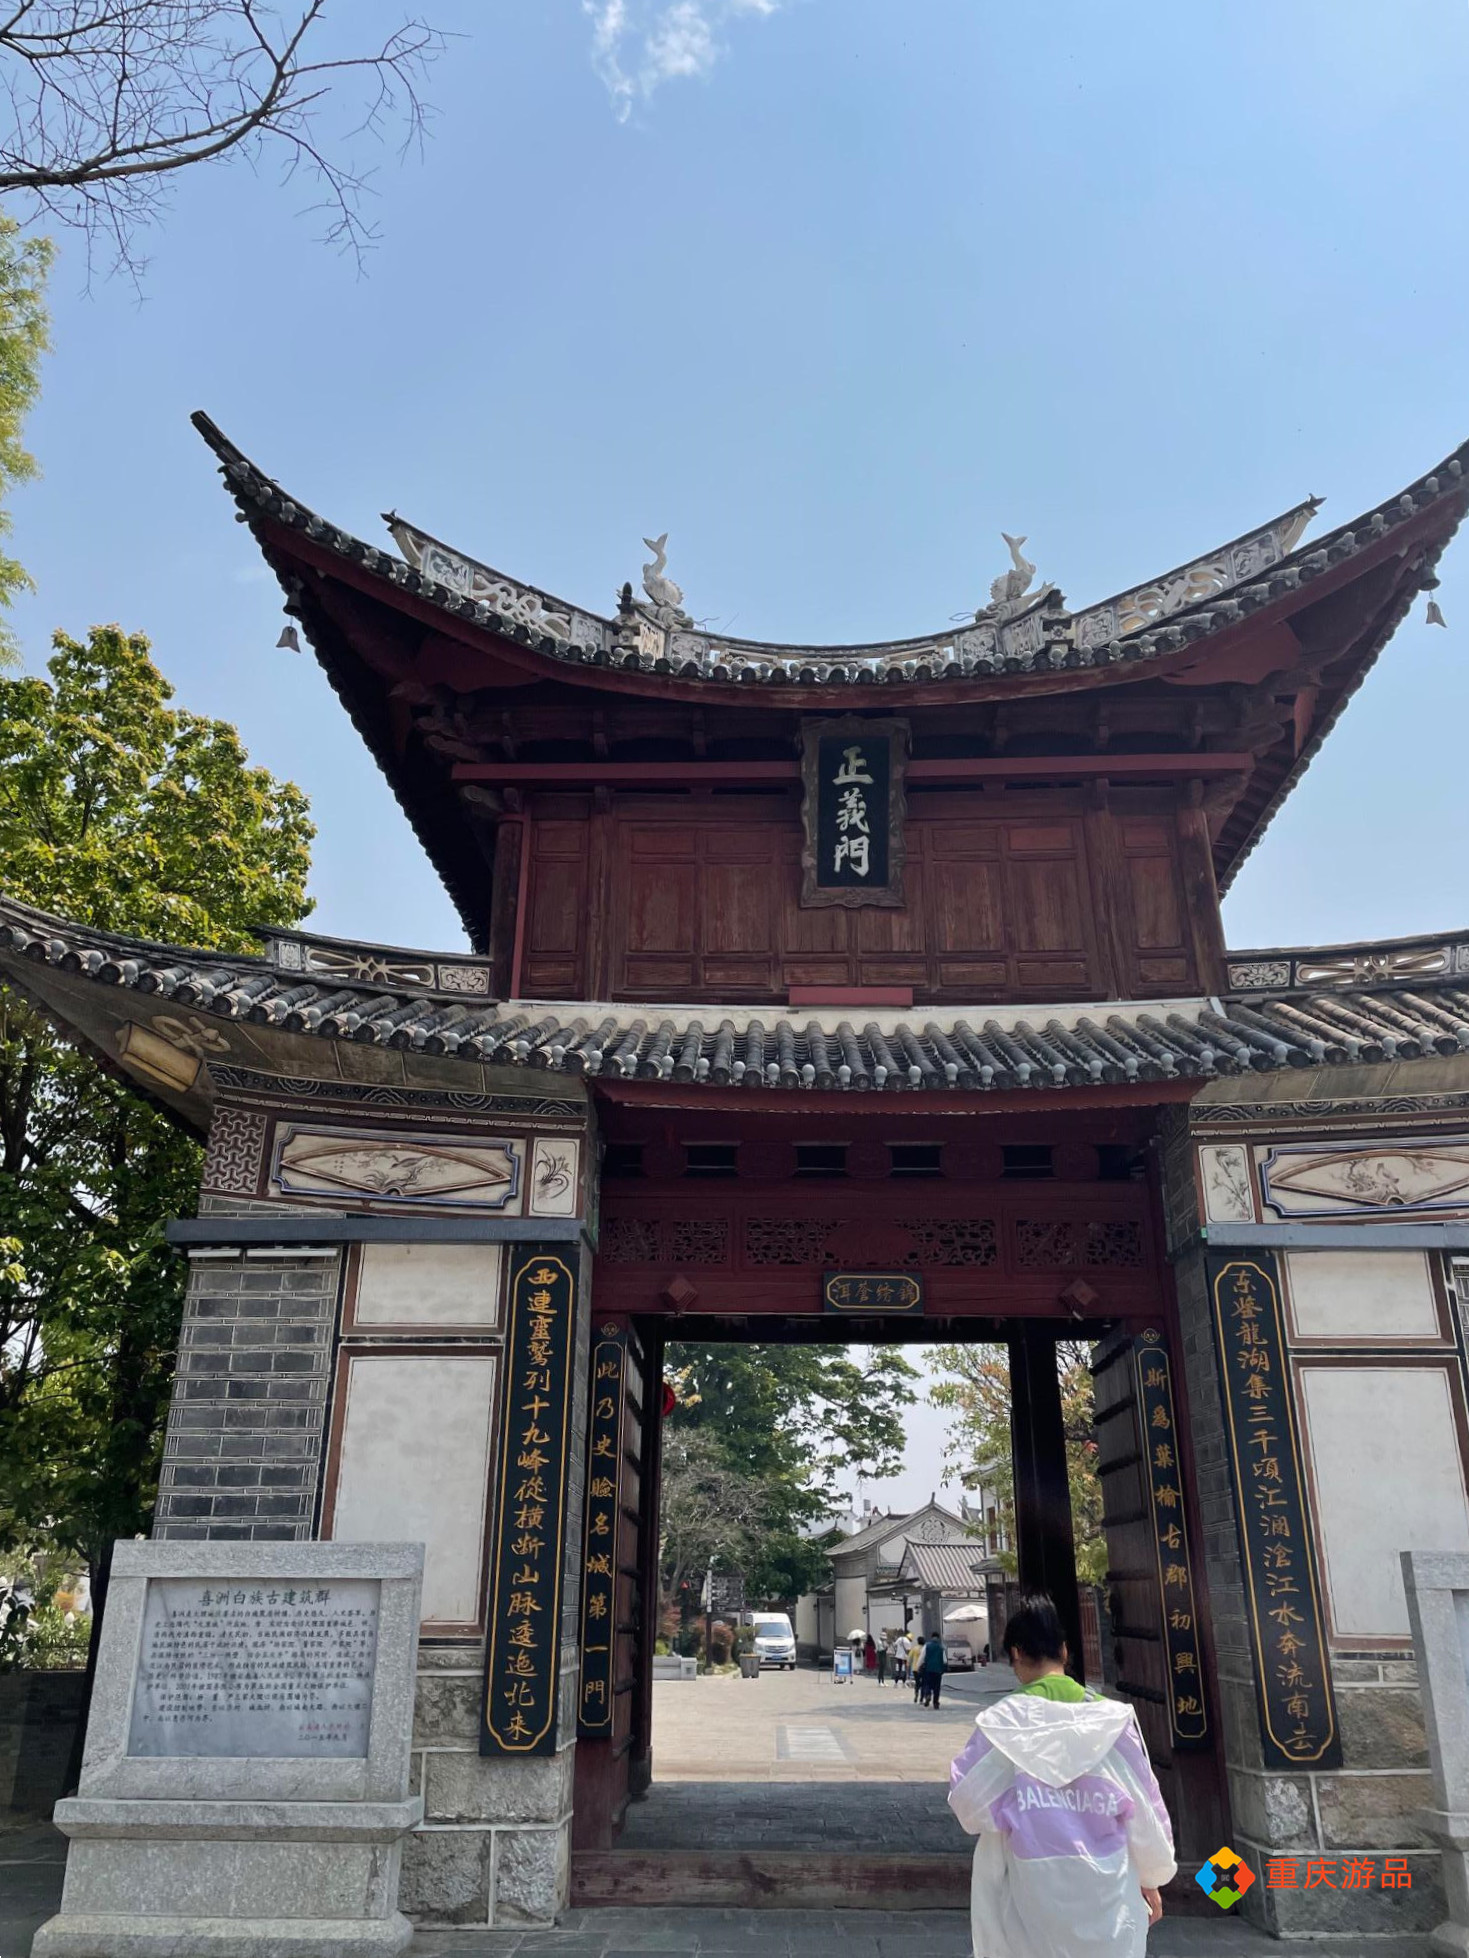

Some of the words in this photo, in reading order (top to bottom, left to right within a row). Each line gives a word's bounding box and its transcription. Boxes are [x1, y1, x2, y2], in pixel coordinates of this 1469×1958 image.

[832, 746, 874, 877] 正義門
[199, 1588, 331, 1607] 喜洲白族古建筑群
[1017, 1786, 1118, 1816] BALENCIAGA
